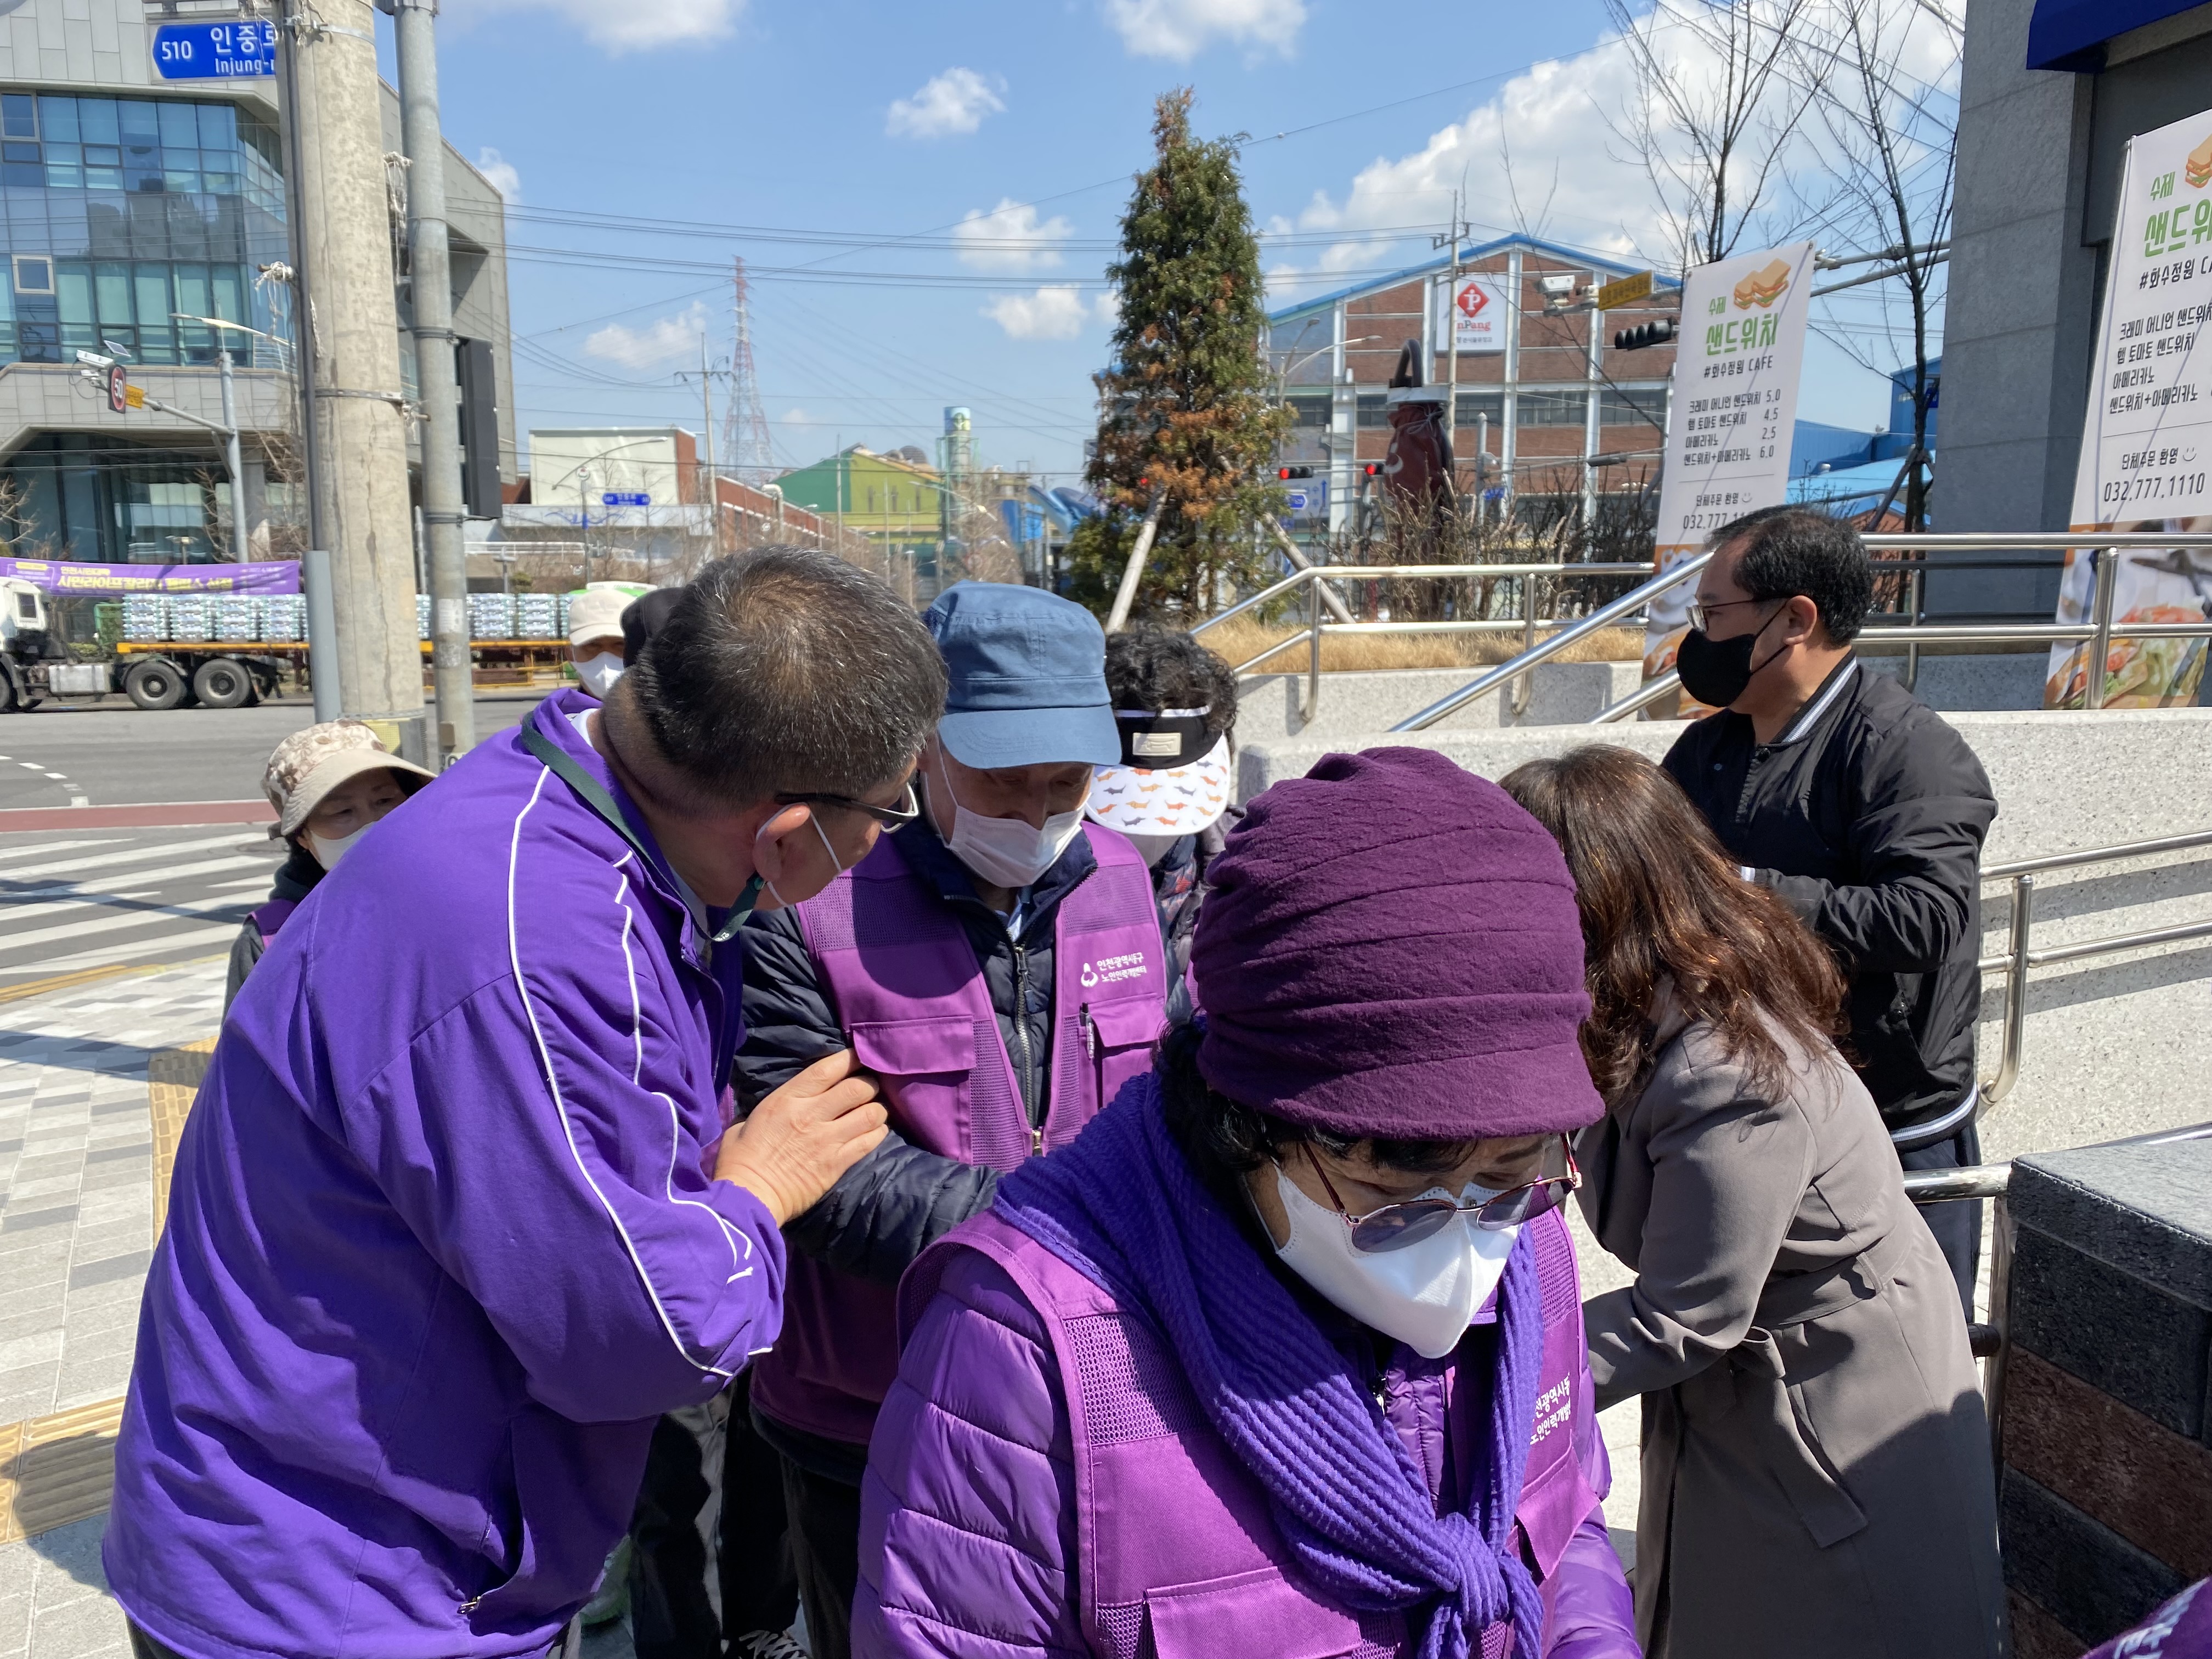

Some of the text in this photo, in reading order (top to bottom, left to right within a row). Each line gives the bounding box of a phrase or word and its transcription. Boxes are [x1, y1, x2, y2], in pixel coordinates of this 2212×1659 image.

[161, 40, 192, 60] 510
[2150, 171, 2176, 201] 수제
[2139, 258, 2196, 290] #화수정원
[1708, 296, 1726, 315] 수제
[1706, 312, 1779, 356] 샌드위치
[2120, 318, 2144, 341] 크래미
[2146, 311, 2174, 334] 어니언
[2118, 332, 2195, 365] 햄 토마토 샌드위치
[1704, 355, 1773, 378] #화수정원 CAFE
[2113, 366, 2154, 390] 아메리카노
[114, 377, 123, 399] 50
[1734, 391, 1762, 407] 샌드위치
[1766, 388, 1781, 403] 5.0
[2109, 383, 2198, 414] 샌드위치+아메리카노
[1697, 415, 1717, 430] 토마토
[1719, 411, 1747, 427] 샌드위치
[1764, 408, 1779, 421] 4.5
[1685, 426, 1776, 448] 아메리카노 2.5
[1684, 445, 1774, 466] 샌드위치+아메리카노 6.0
[2122, 447, 2179, 470] 단체주문 환영
[2104, 472, 2205, 502] 032.777.1110
[1696, 493, 1739, 506] 단체주문 환영
